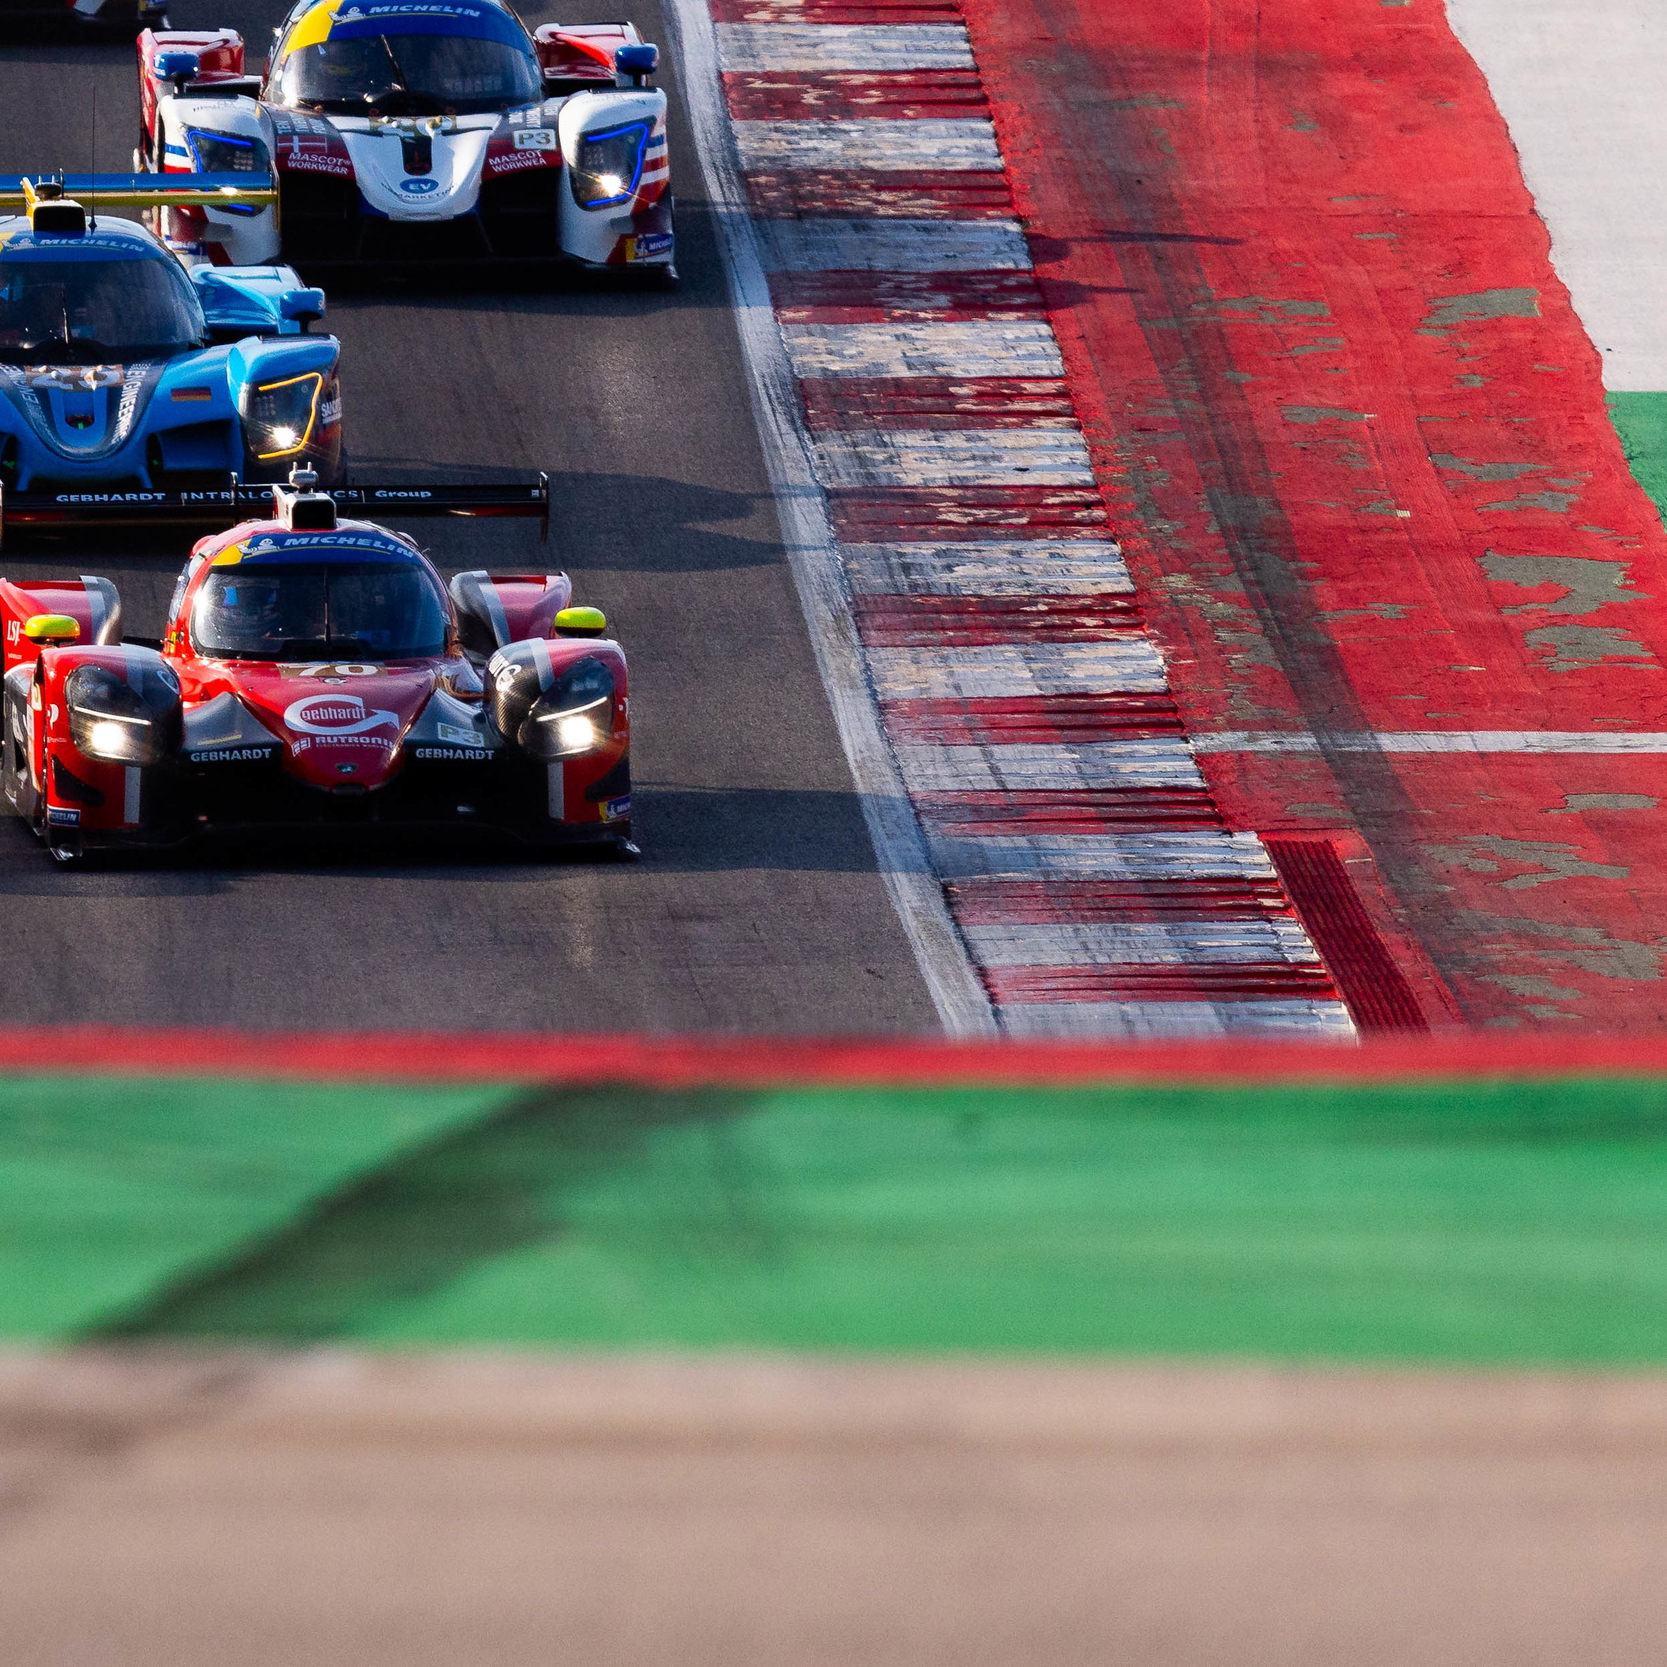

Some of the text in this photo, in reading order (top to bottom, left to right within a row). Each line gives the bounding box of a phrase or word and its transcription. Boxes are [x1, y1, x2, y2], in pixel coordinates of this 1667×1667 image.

[368, 4, 482, 18] MICHELIN
[518, 132, 552, 148] P3
[488, 149, 543, 166] MASCOT
[286, 159, 349, 175] WORKWEAR
[408, 182, 432, 191] EV
[39, 238, 145, 252] MICHELIN
[55, 488, 432, 503] GEBHARDT INTRALOICS Group
[283, 535, 415, 559] MICHELIN
[300, 708, 367, 721] gebhardt
[440, 726, 484, 745] P3
[190, 748, 273, 763] GEBHARDT
[415, 748, 495, 760] GEBHARDT
